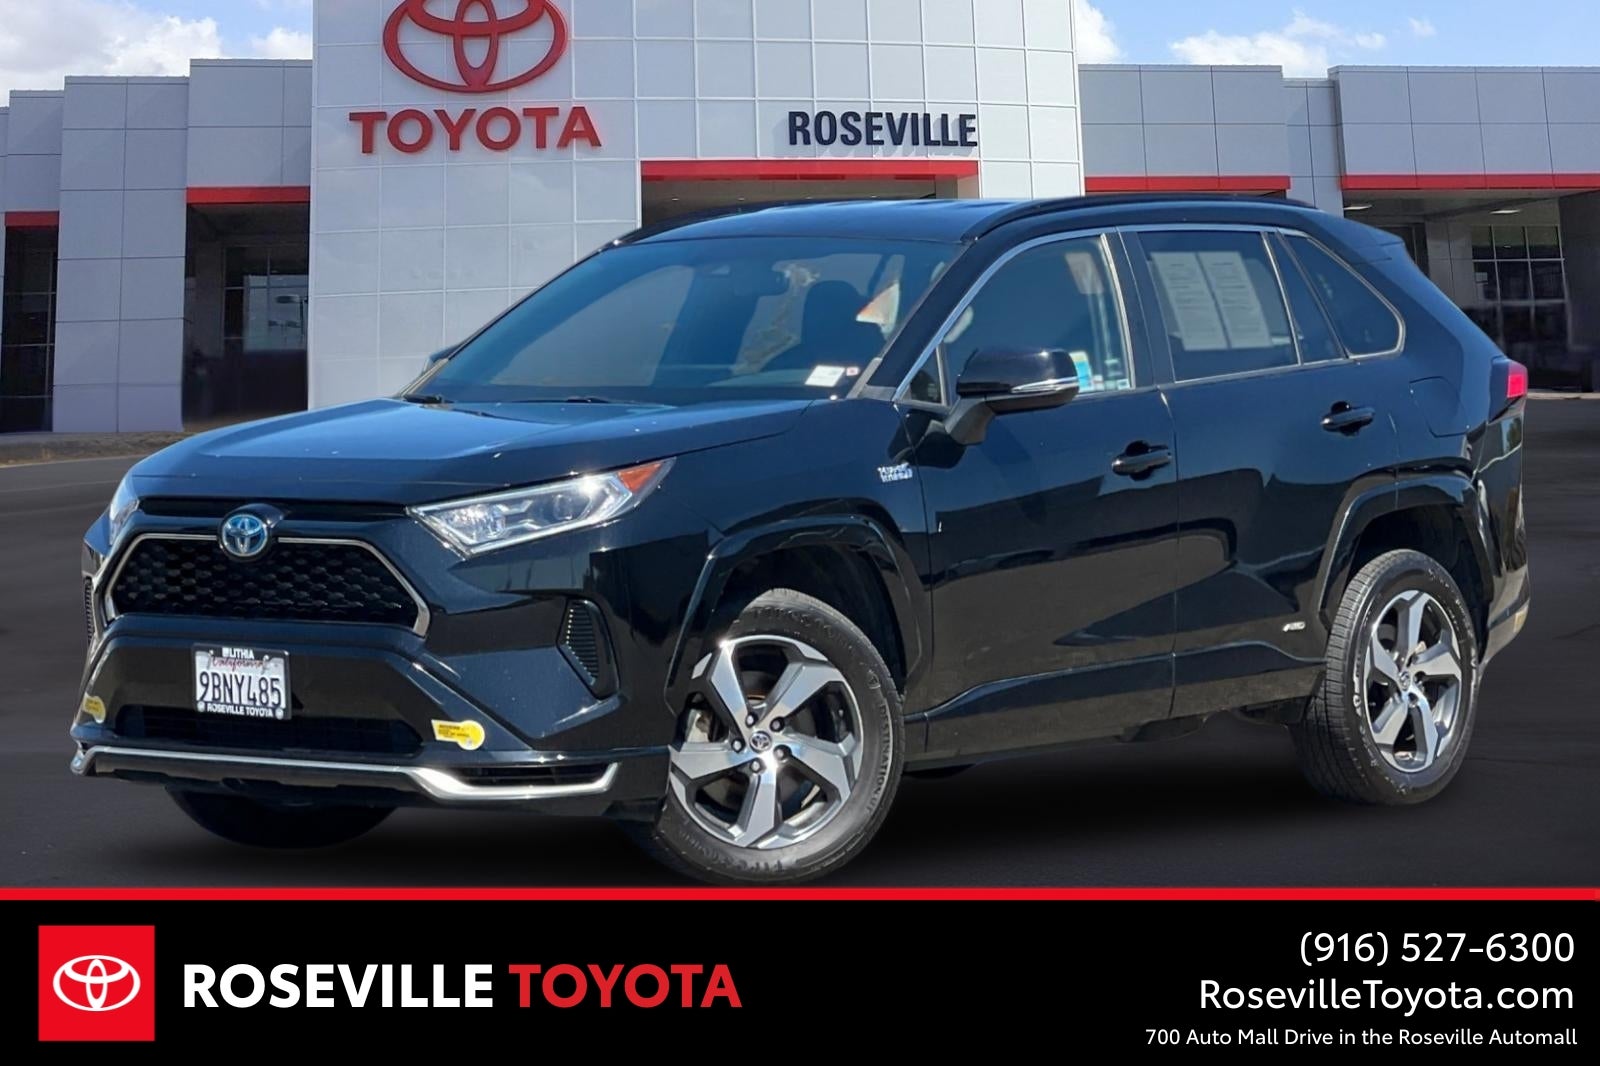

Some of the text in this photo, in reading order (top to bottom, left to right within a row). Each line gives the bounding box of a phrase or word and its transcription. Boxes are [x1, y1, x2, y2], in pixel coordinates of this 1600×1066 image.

[349, 106, 602, 154] TOYOTA
[787, 110, 979, 148] ROSEVILLE
[229, 648, 254, 659] LITHIA
[199, 672, 281, 706] 9BNY485
[207, 704, 274, 717] ROSEVILLE TOYOTA
